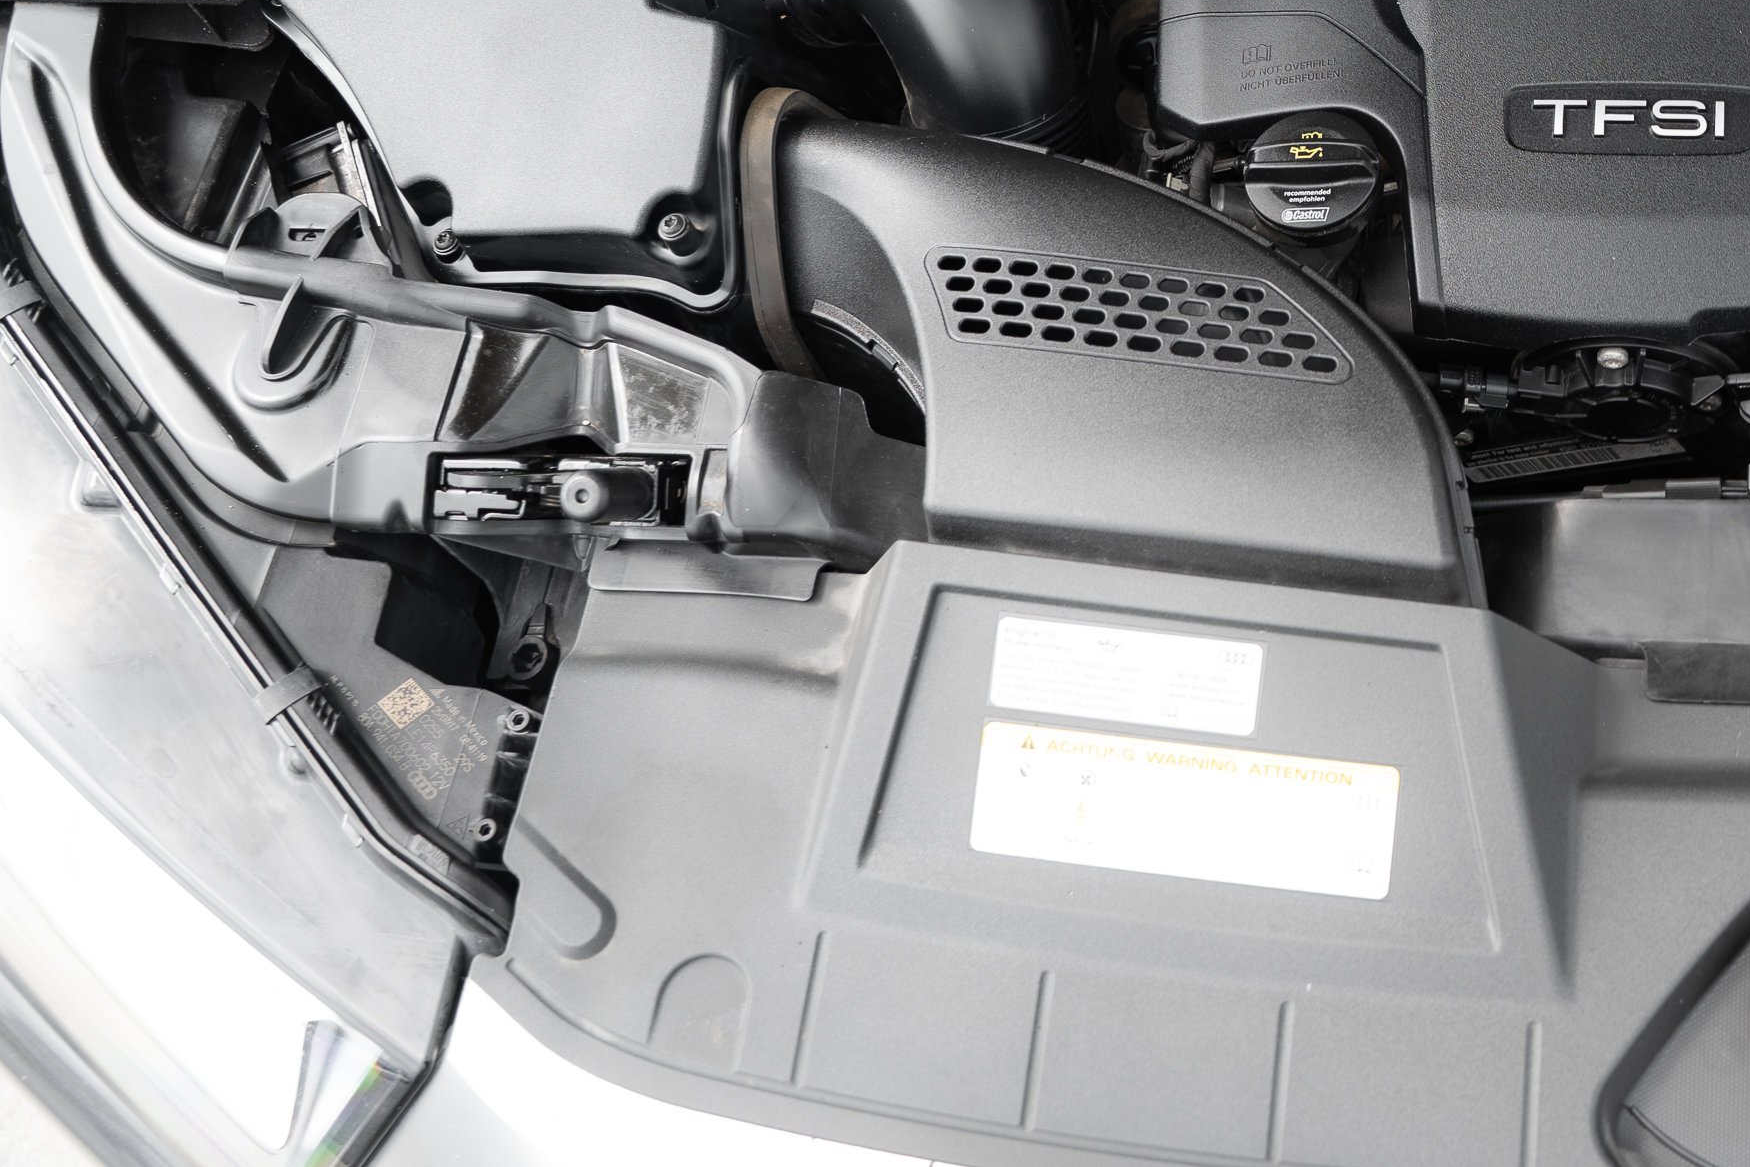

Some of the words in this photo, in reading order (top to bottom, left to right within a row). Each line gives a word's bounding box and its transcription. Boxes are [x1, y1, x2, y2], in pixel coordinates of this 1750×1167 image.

[1240, 80, 1270, 91] NICHT
[1241, 70, 1255, 79] DO
[1260, 66, 1280, 76] NOT
[1532, 99, 1726, 139] TFSI
[1293, 209, 1325, 220] Castrol
[441, 695, 461, 717] Made
[457, 714, 467, 724] in
[465, 720, 489, 747] Mexico
[1046, 740, 1135, 762] ACHTUNG
[1146, 753, 1238, 773] WARNING
[1248, 764, 1353, 786] ATTENTION
